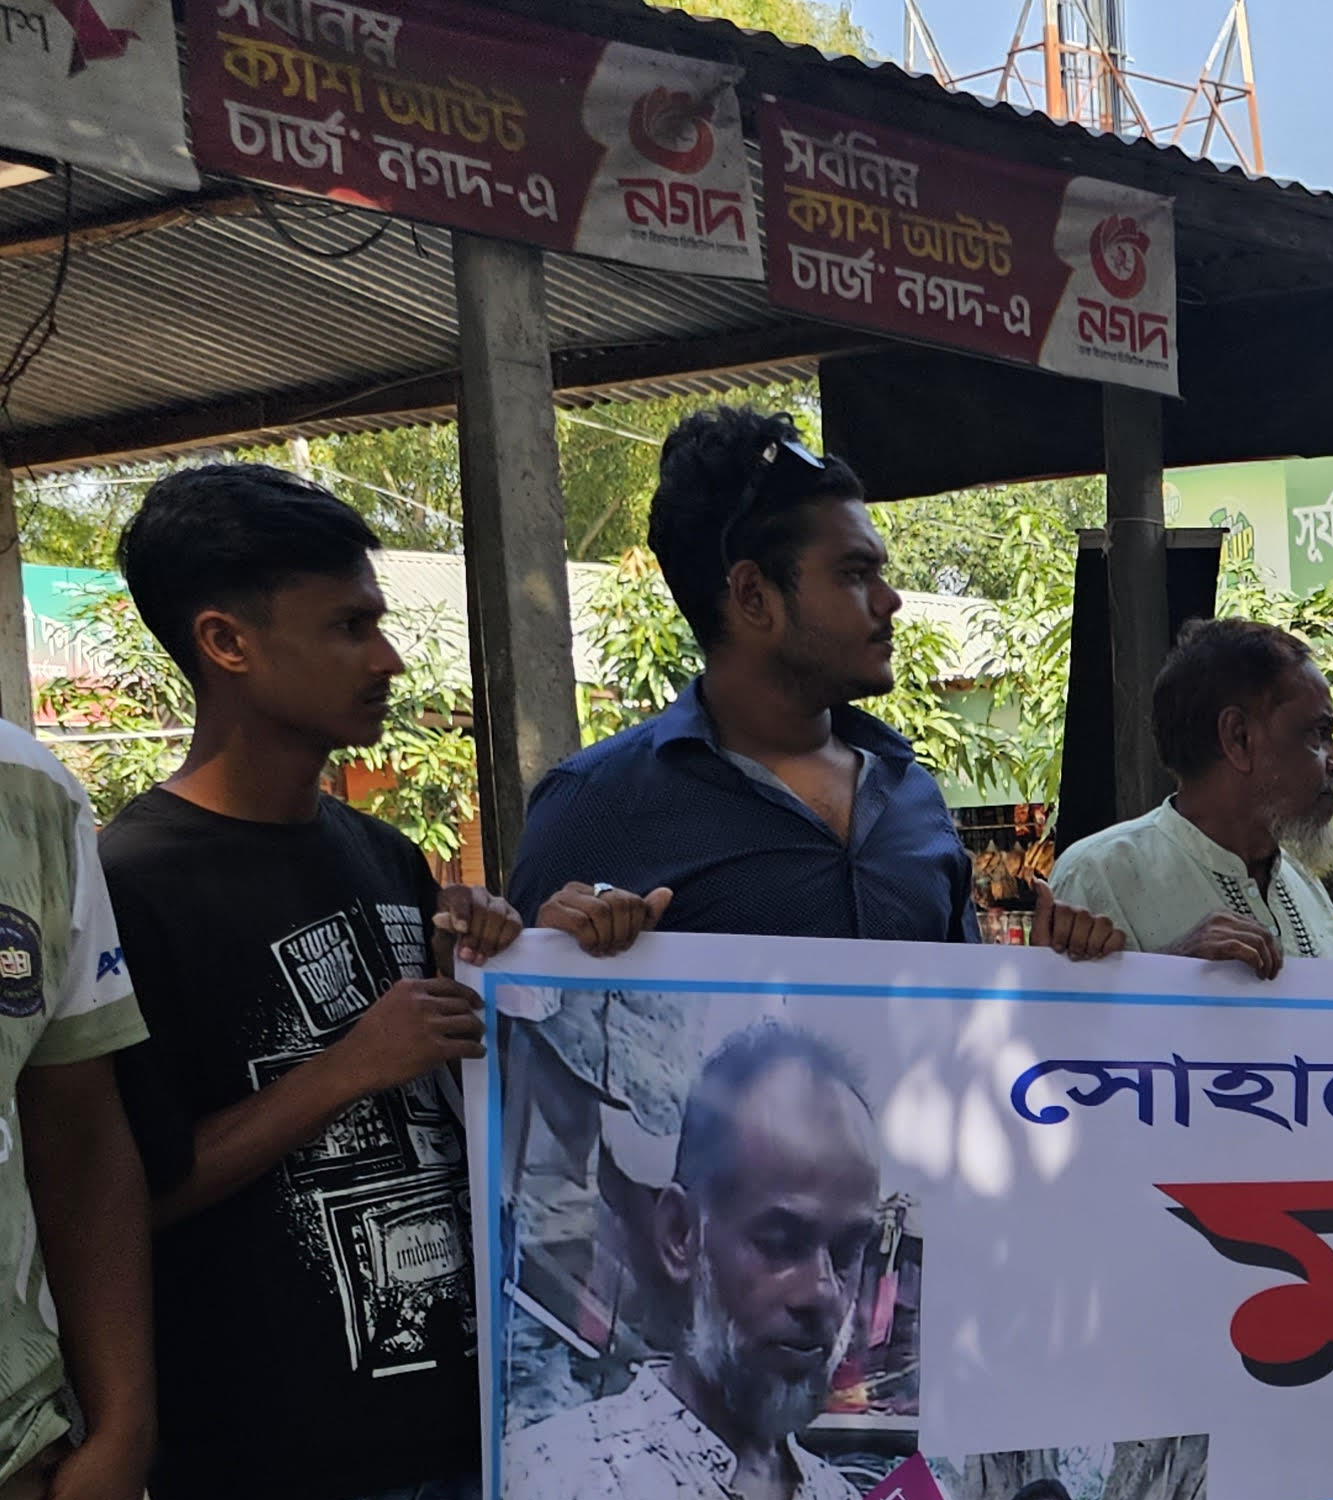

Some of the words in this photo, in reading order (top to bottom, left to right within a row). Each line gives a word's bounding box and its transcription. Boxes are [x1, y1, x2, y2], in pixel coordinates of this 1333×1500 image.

[217, 31, 365, 114] ক্যাশ
[375, 72, 529, 153] আউট
[223, 99, 346, 175] চার্জ
[372, 134, 559, 223] নগদ-এ
[780, 130, 920, 208] সর্বনিম্ন
[619, 177, 746, 242] নগদ
[784, 184, 892, 250] ক্যাশ
[902, 211, 1013, 277] আউট
[787, 243, 876, 304] চার্জ
[895, 266, 1032, 337] নগদ-এ
[1077, 297, 1169, 360] নগদ
